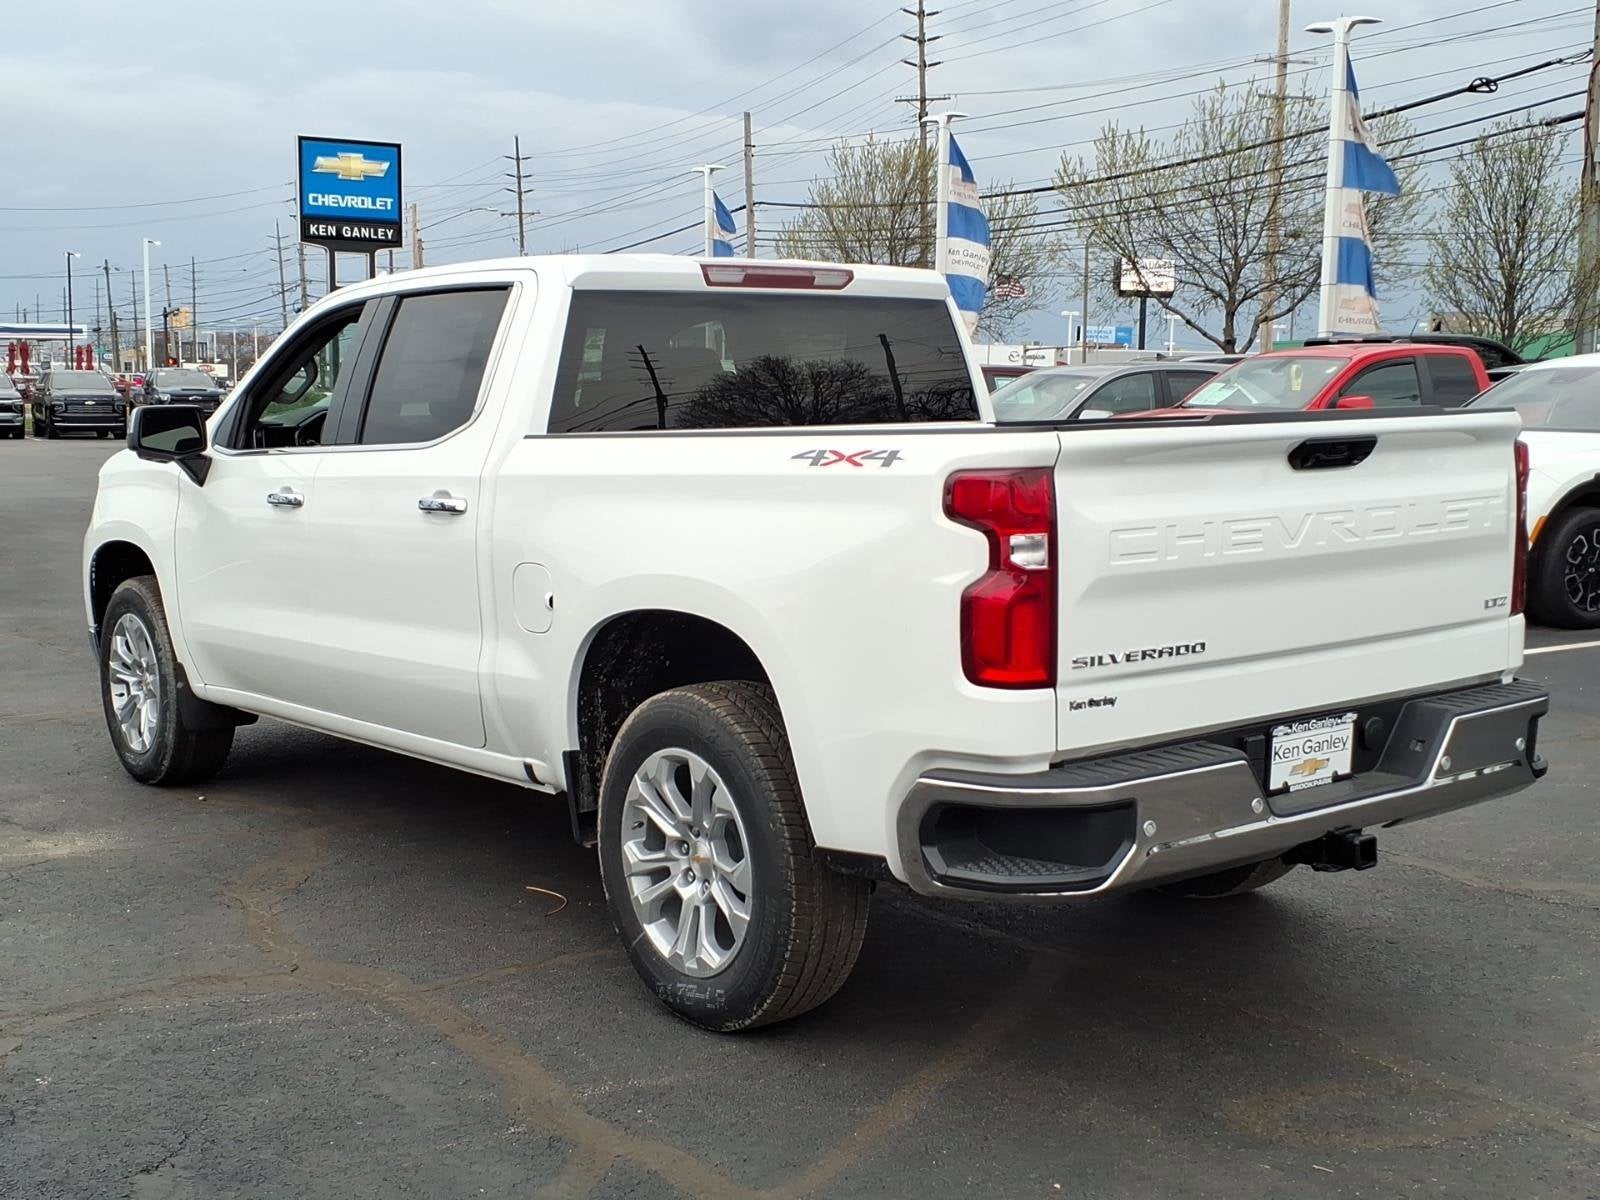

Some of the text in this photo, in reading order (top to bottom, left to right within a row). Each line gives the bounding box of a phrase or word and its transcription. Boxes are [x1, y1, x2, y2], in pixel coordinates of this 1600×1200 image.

[308, 193, 394, 210] CHEVROLET
[309, 224, 394, 239] KEN GANLEY
[948, 247, 989, 266] Ken Ganley
[1109, 495, 1503, 565] CHEVROLET
[1484, 596, 1508, 609] LTZ
[1071, 641, 1206, 670] SILVERADO
[1069, 696, 1117, 711] Ken Ganley
[1291, 716, 1337, 733] Ken Ganley
[1273, 734, 1349, 762] Ken Ganley
